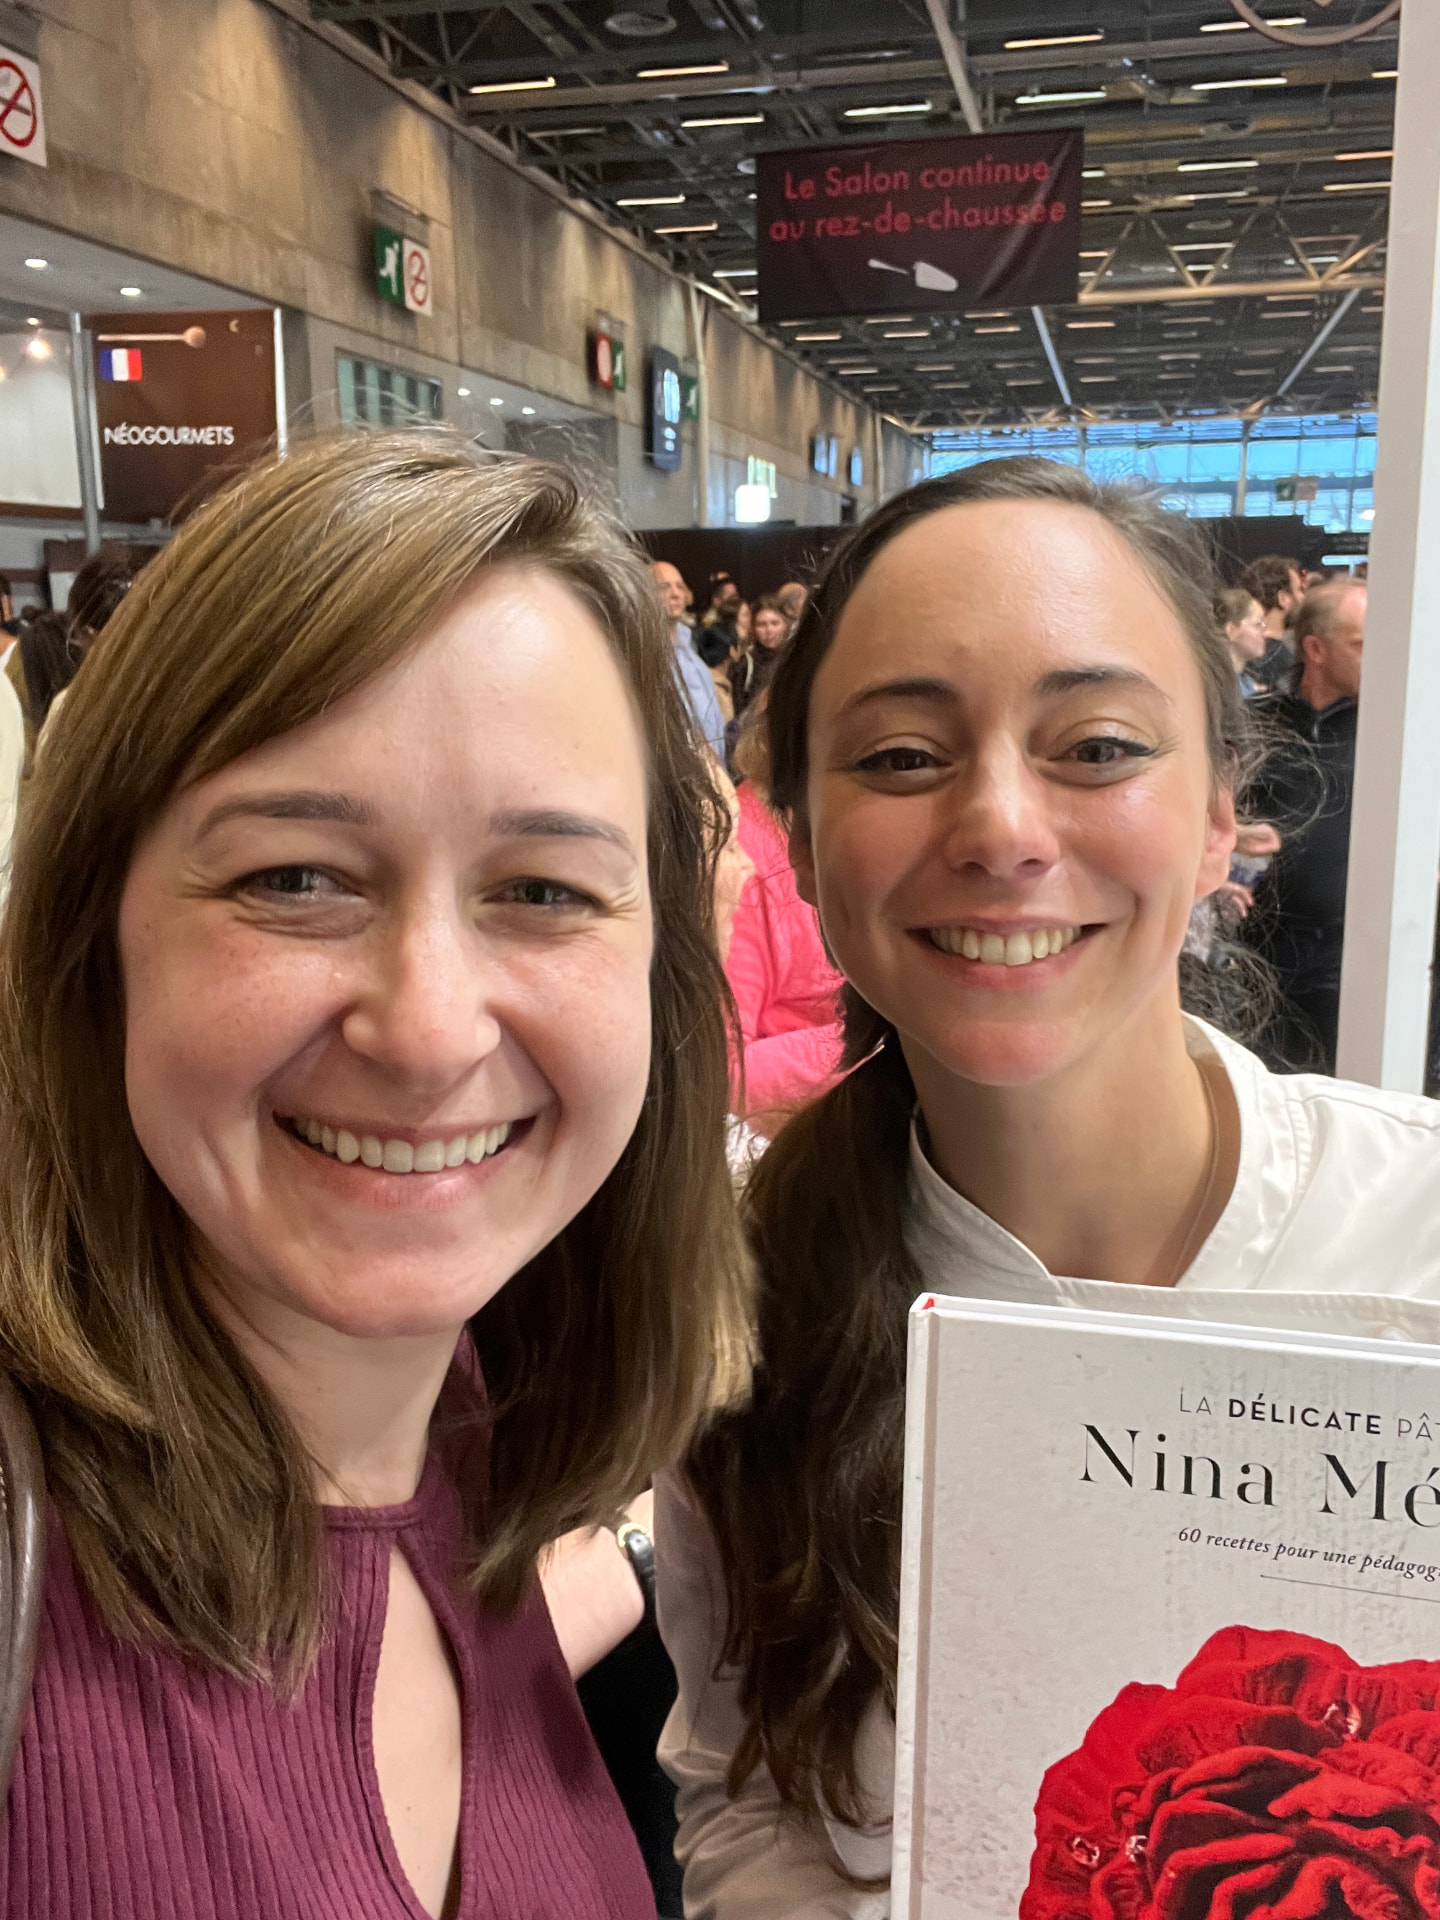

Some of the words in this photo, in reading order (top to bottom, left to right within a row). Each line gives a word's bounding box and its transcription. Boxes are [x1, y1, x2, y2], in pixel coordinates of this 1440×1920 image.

[783, 170, 817, 201] Le
[825, 161, 911, 198] Salon
[919, 154, 1052, 190] continue
[768, 217, 806, 242] au
[815, 196, 1067, 238] rez-de-chaussée
[103, 421, 235, 446] NÉOGOURMETS
[1179, 1388, 1213, 1416] LA
[1228, 1393, 1382, 1435] DÉLICATE
[1078, 1422, 1278, 1509] Nina
[1319, 1452, 1440, 1529] Mé
[1178, 1526, 1202, 1545] 60
[1205, 1533, 1271, 1554] recettes
[1273, 1542, 1319, 1561] pour
[1322, 1550, 1357, 1566] une
